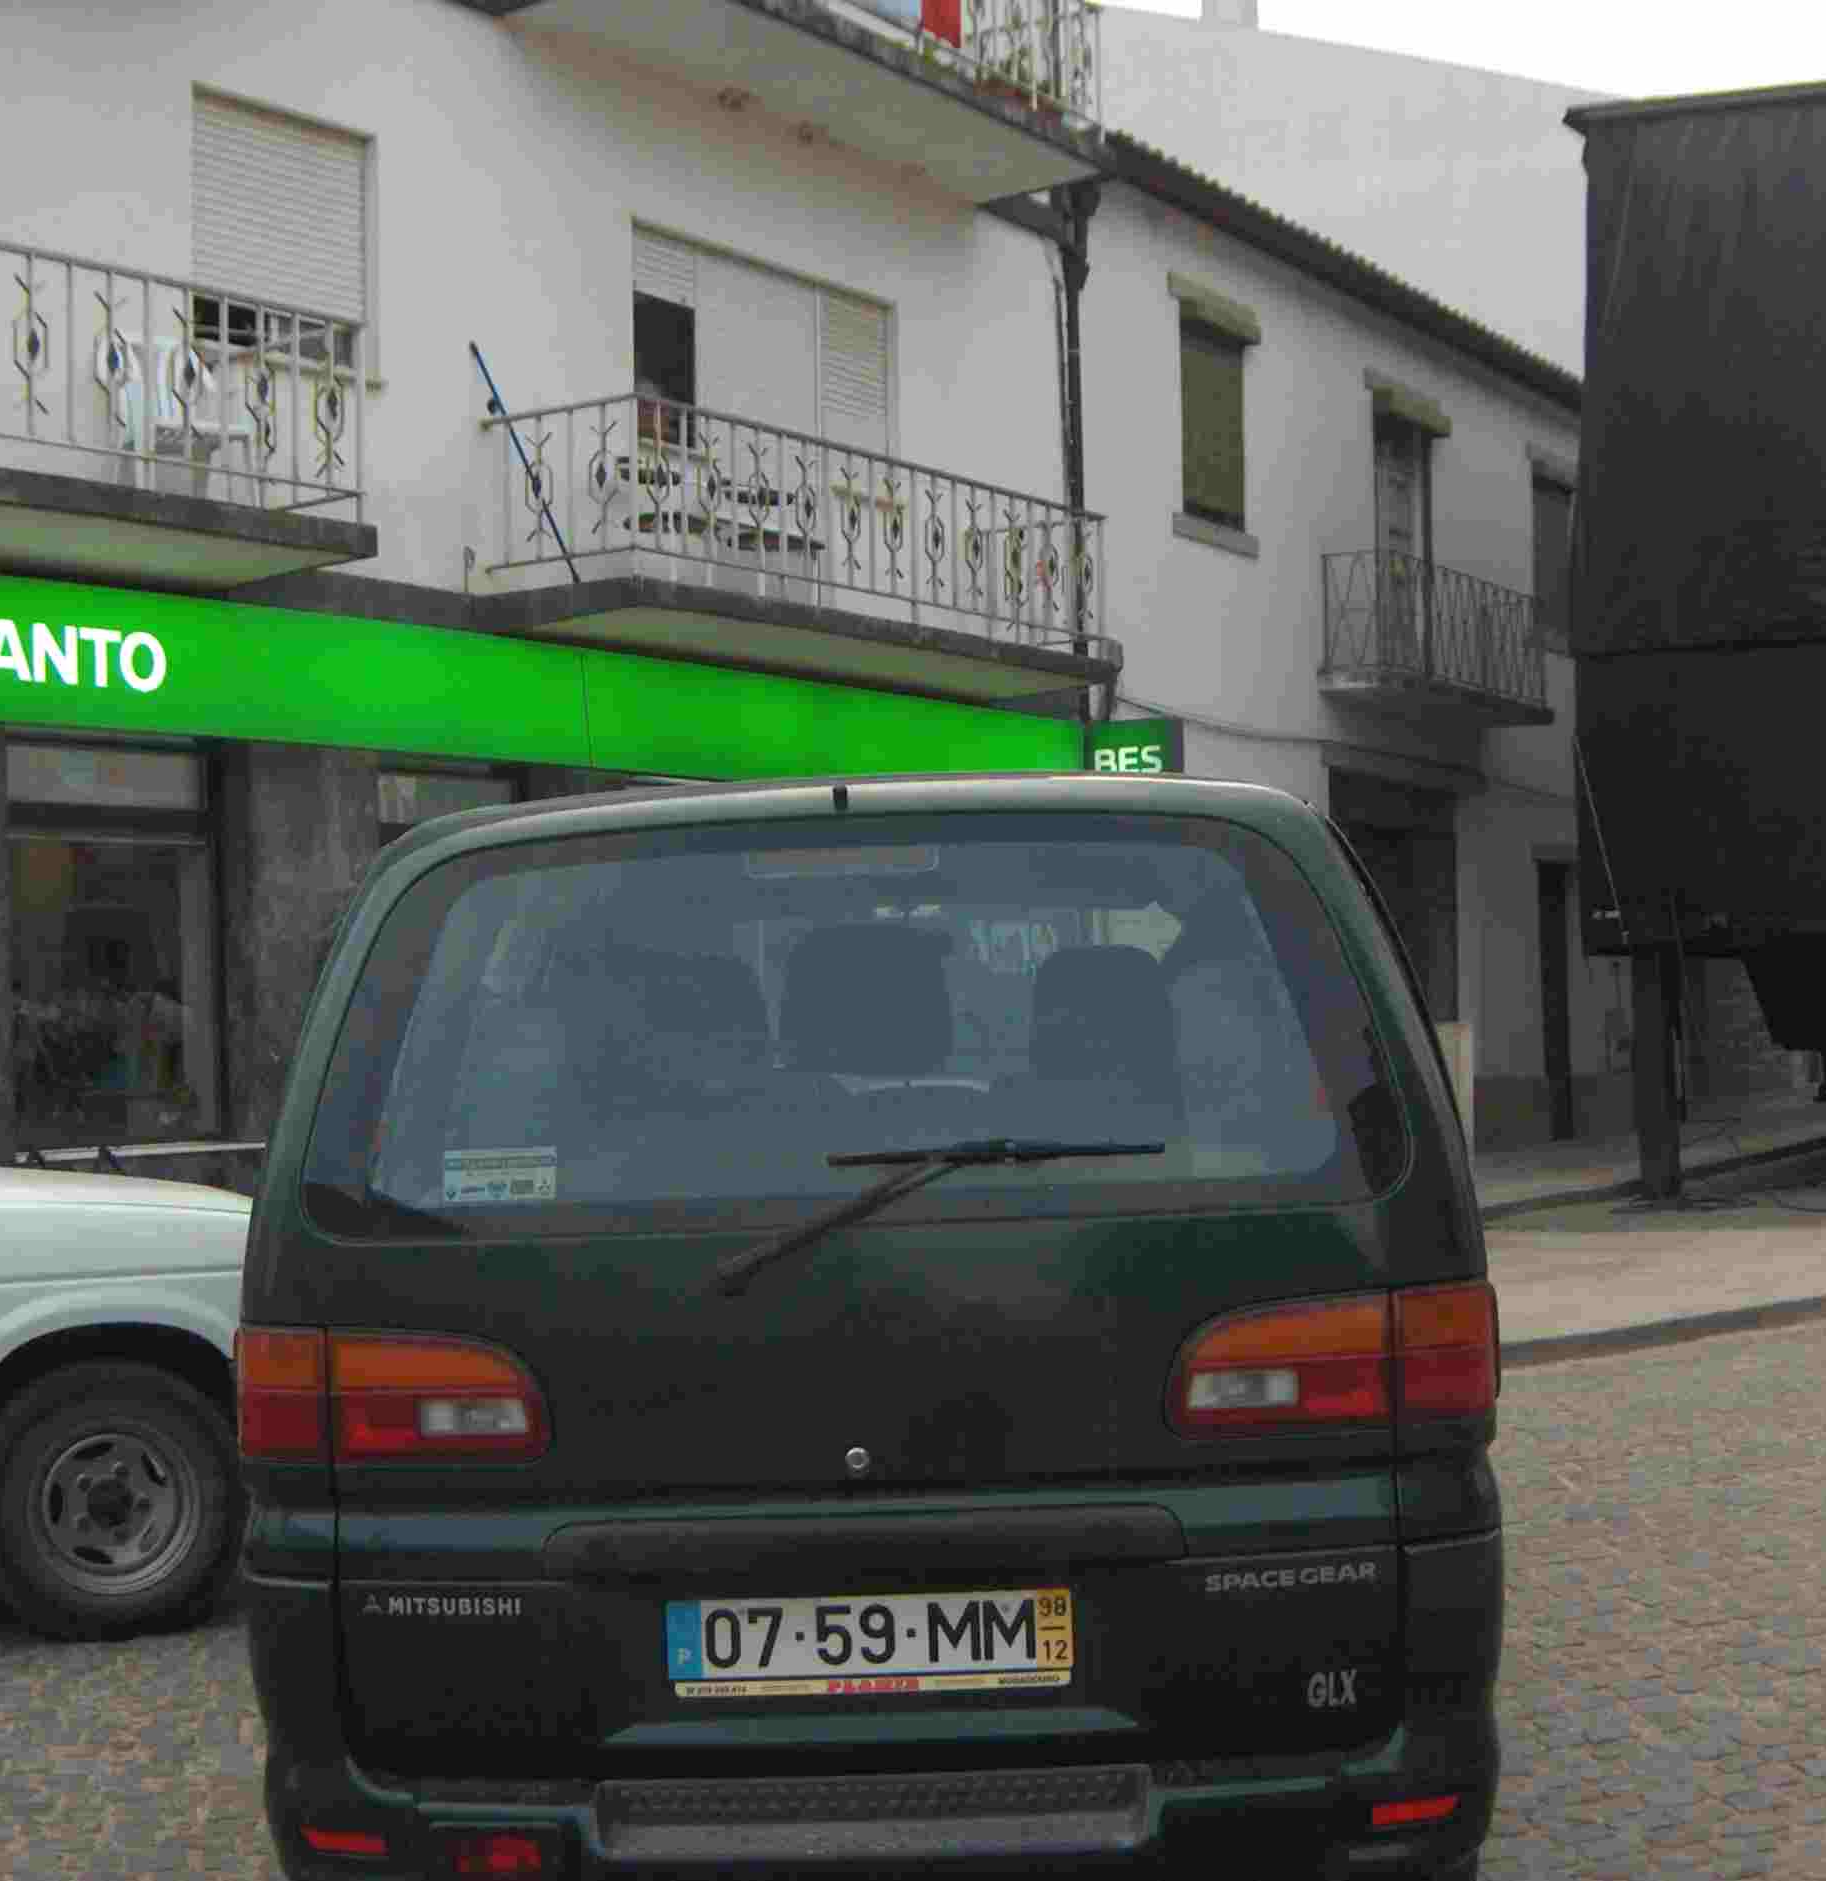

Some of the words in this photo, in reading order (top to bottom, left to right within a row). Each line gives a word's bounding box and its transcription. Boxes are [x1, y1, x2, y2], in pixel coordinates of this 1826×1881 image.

[1204, 1569, 1294, 1592] SPACE
[1299, 1561, 1376, 1584] GEAR
[388, 1597, 522, 1616] MITSUBISHI
[1042, 1640, 1069, 1661] 12
[1307, 1668, 1357, 1708] GLX
